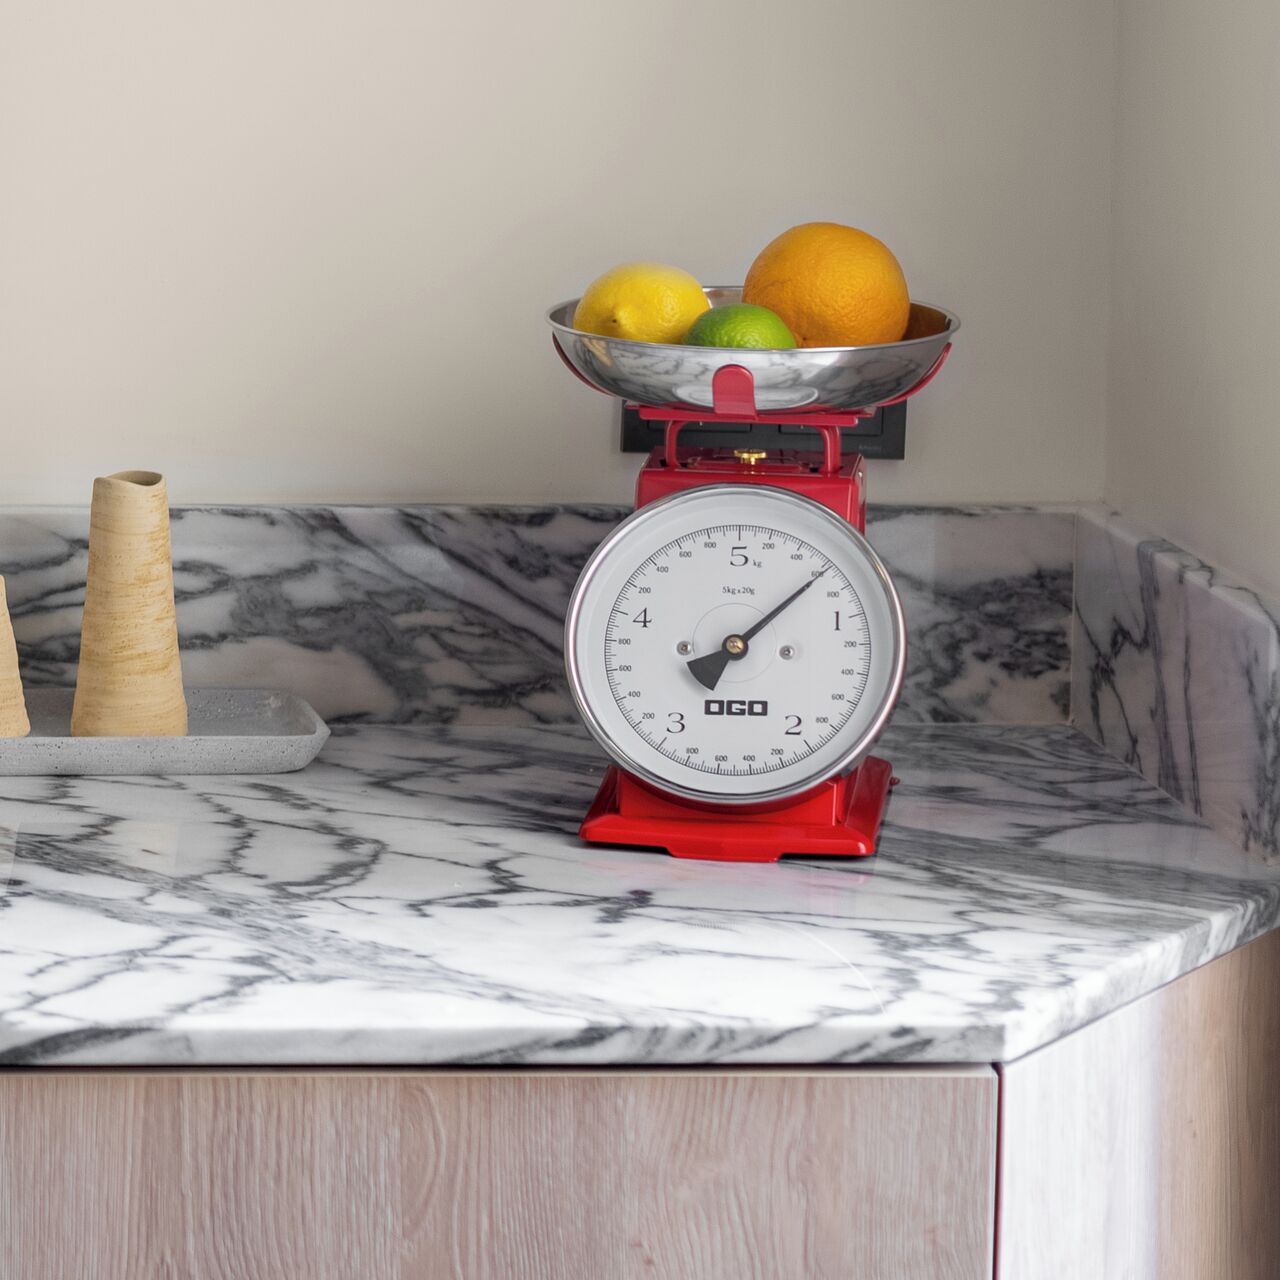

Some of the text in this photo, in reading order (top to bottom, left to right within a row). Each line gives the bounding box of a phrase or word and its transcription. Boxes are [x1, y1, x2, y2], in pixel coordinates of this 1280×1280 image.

[703, 541, 717, 549] 800
[762, 542, 775, 550] 200
[679, 550, 692, 558] 600
[729, 545, 749, 567] 5
[790, 553, 803, 561] 400
[638, 586, 651, 594] 200
[632, 607, 653, 628] 4
[834, 611, 841, 631] 1
[618, 638, 631, 646] 800
[844, 640, 857, 648] 200
[841, 668, 854, 676] 400
[831, 693, 845, 701] 600
[666, 712, 686, 734] 3
[784, 714, 803, 736] 2
[770, 748, 784, 756] 200
